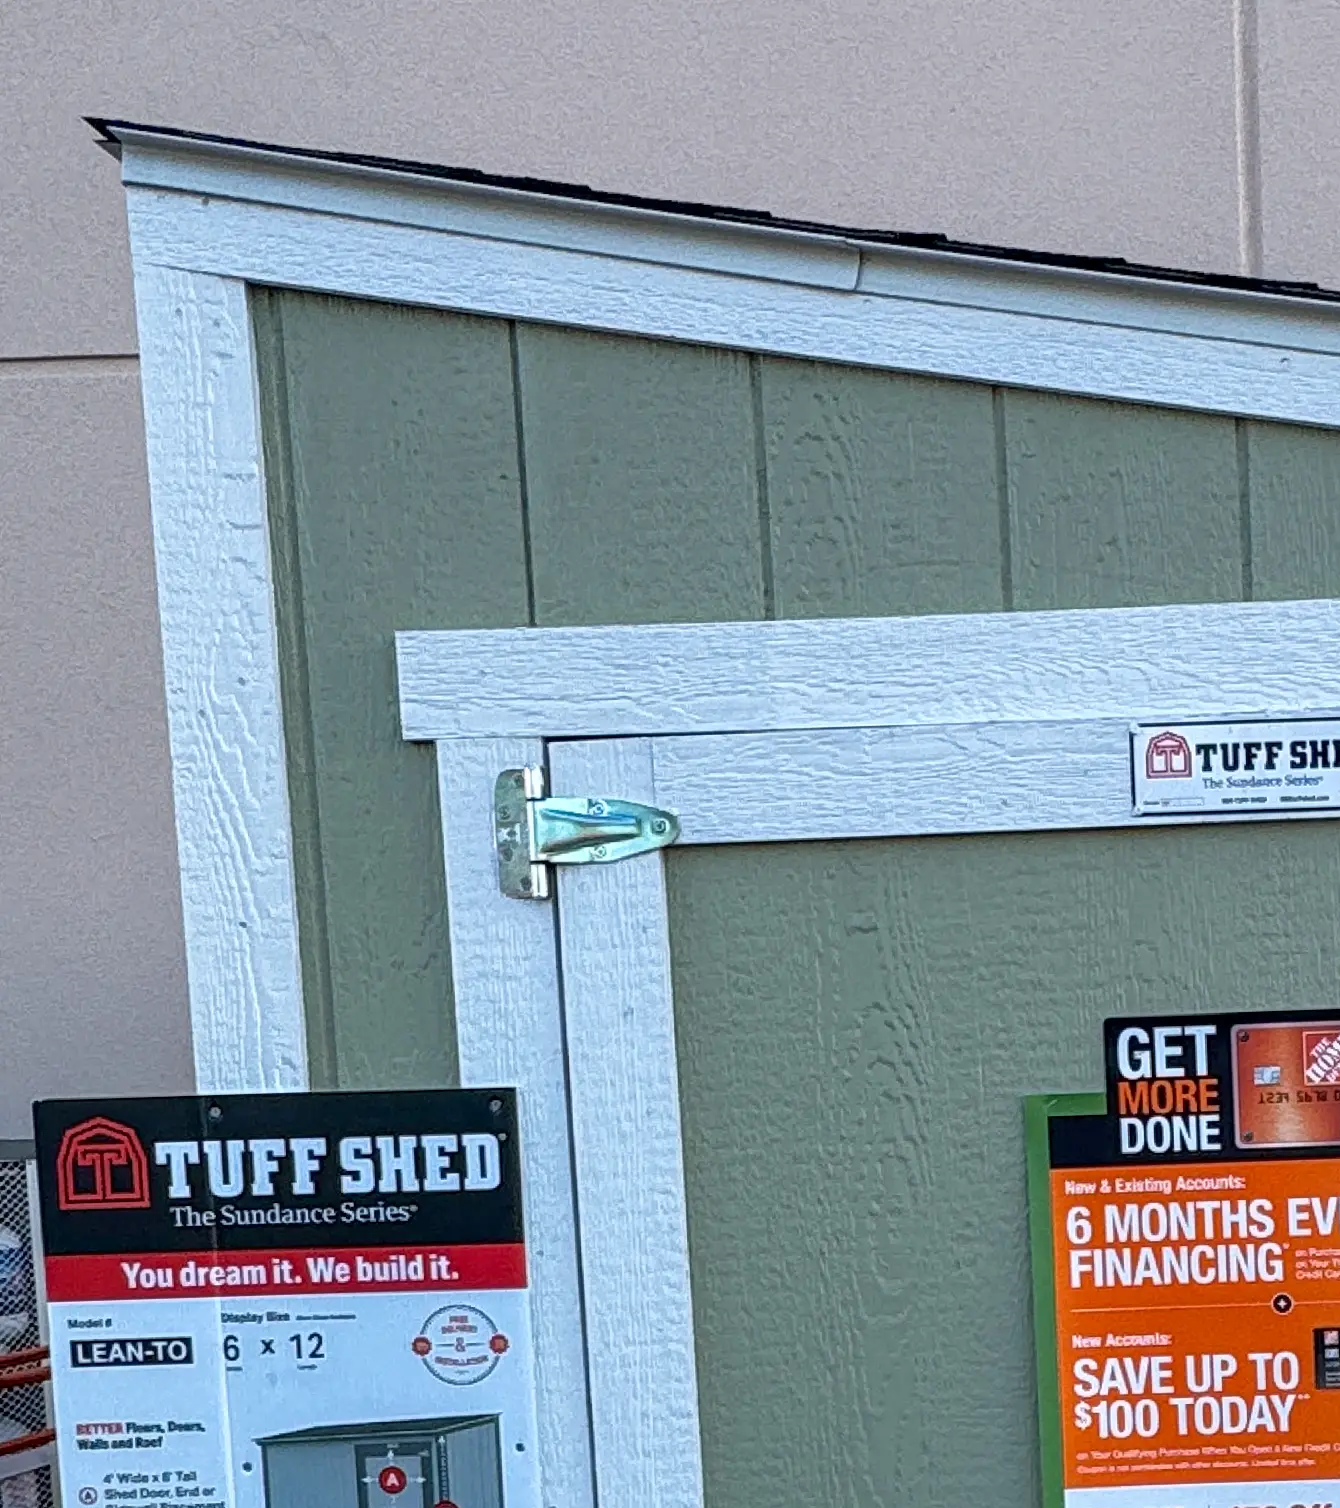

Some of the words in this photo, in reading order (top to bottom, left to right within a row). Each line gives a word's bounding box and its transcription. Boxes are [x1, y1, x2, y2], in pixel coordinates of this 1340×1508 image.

[1195, 741, 1283, 772] TUFF
[1203, 778, 1224, 789] The
[1227, 777, 1282, 789] Sundance
[1117, 1025, 1217, 1079] GET
[1118, 1078, 1219, 1116] MORE
[1120, 1113, 1222, 1155] DONE
[154, 1136, 327, 1199] TUFF
[339, 1133, 502, 1195] SHED
[1065, 1180, 1096, 1195] New
[1099, 1178, 1112, 1194] &
[1115, 1176, 1172, 1195] Existing
[1176, 1174, 1246, 1192] Accounts:
[170, 1206, 216, 1228] The
[219, 1203, 338, 1227] Sundance
[1067, 1206, 1091, 1245] 6
[1105, 1199, 1275, 1243] MONTHS
[121, 1260, 173, 1290] You
[182, 1257, 266, 1287] dream
[272, 1257, 302, 1284] it.
[307, 1256, 351, 1283] We
[357, 1254, 425, 1282] build
[430, 1254, 460, 1280] it.
[67, 1319, 103, 1329] Model
[221, 1312, 263, 1325] Display
[76, 1340, 188, 1363] LEAN-TO
[223, 1334, 240, 1361] 6
[260, 1339, 276, 1355] x
[289, 1332, 325, 1359] 12
[455, 1337, 466, 1352] &
[1072, 1334, 1101, 1348] New
[1104, 1333, 1172, 1347] Accounts:
[1073, 1357, 1174, 1397] SAVE
[1197, 1355, 1237, 1391] UP
[1248, 1351, 1299, 1390] TO
[76, 1423, 123, 1435] BETTER
[1074, 1400, 1159, 1438] $100
[77, 1439, 109, 1450] Walls
[111, 1438, 133, 1449] and
[135, 1436, 163, 1448] Roof
[387, 1473, 400, 1487] A
[104, 1488, 137, 1500] Shed
[176, 1487, 199, 1497] End
[202, 1488, 216, 1496] or
